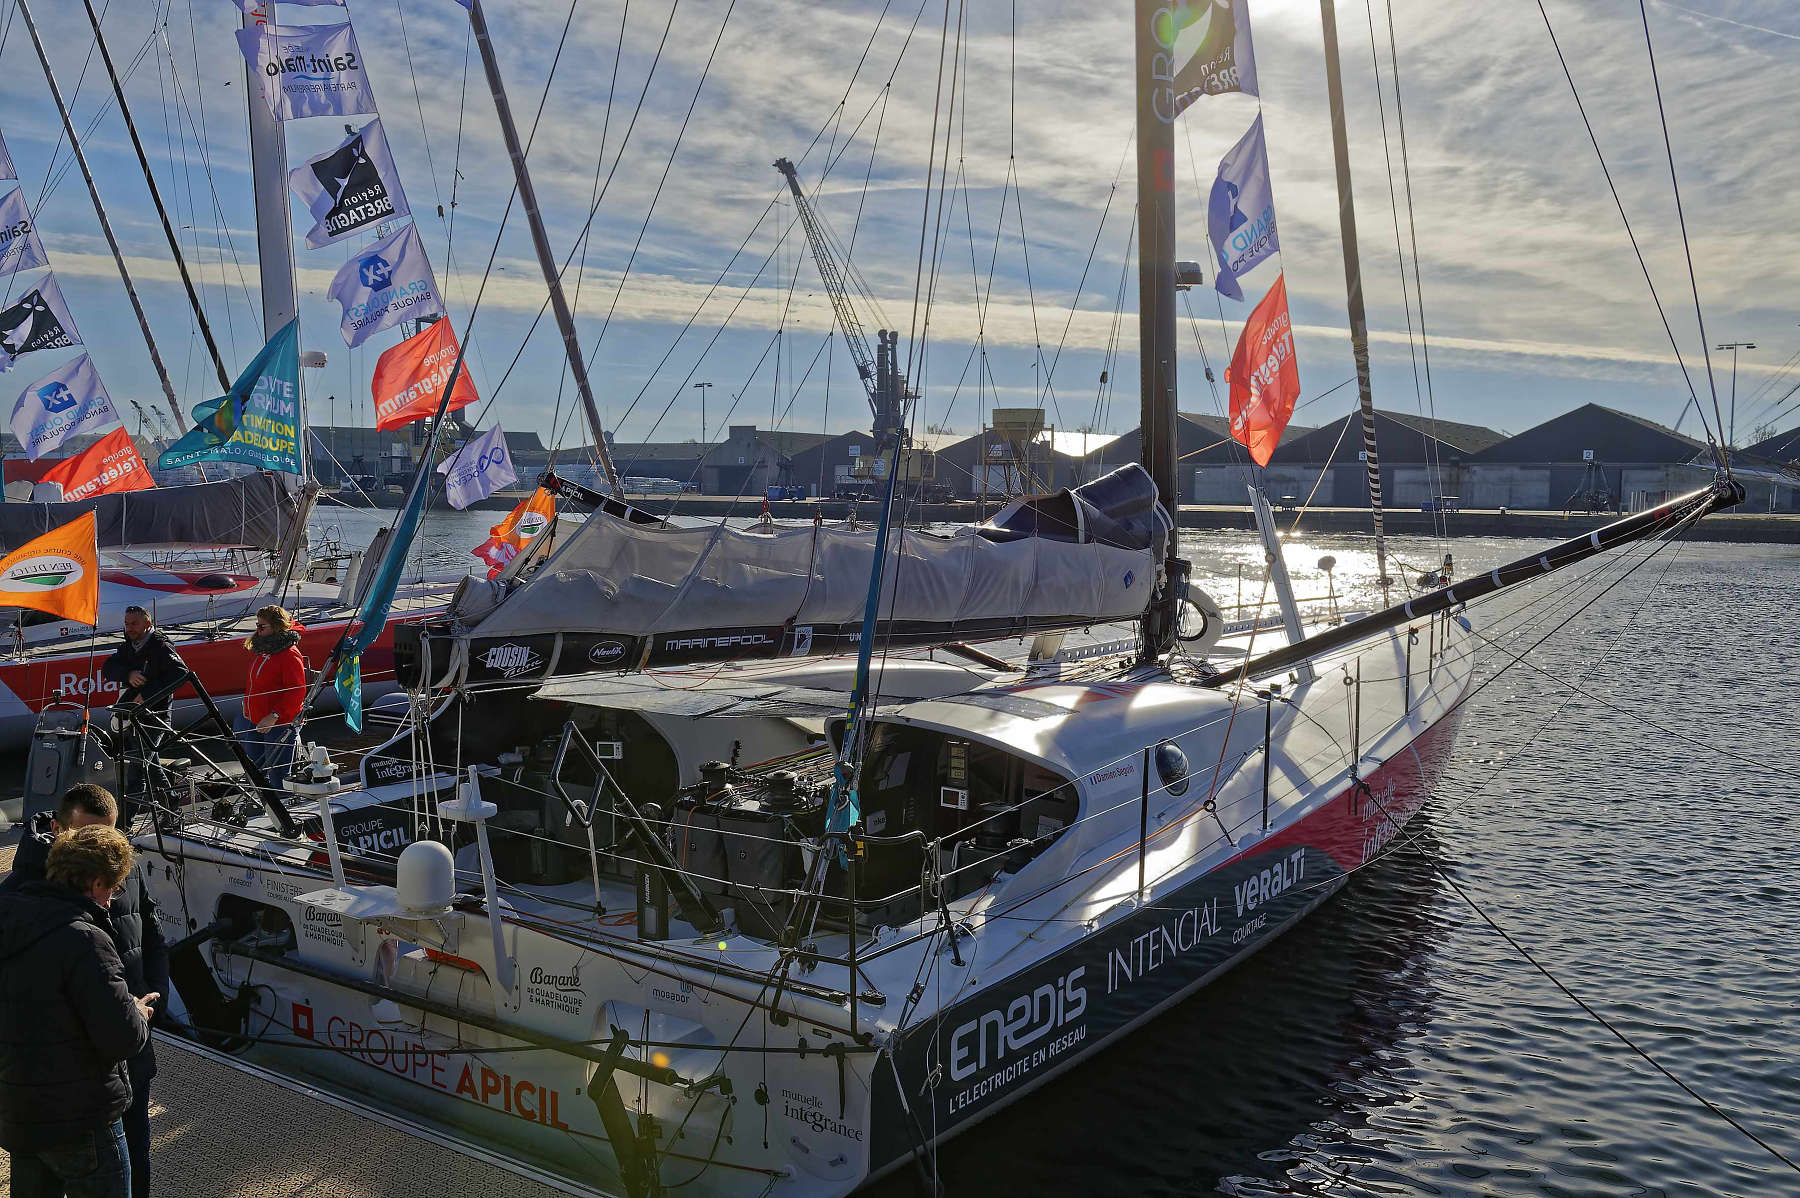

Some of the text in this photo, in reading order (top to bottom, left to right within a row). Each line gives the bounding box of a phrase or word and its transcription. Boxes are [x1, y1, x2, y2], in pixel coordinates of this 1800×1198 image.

[666, 633, 774, 651] MARINEPOOL
[486, 646, 530, 668] COUSIN
[60, 669, 122, 697] Rola
[341, 818, 384, 837] GROUPE
[347, 826, 412, 856] APICIL
[310, 932, 344, 947] MARTINIQUE
[1232, 912, 1267, 944] COURTAGE
[1108, 897, 1221, 995] INTENCIAL
[530, 966, 584, 993] Banane
[534, 997, 580, 1015] MARTINIQUE
[535, 988, 582, 1008] GUADELOUPE
[327, 1016, 448, 1089] GROUPE
[950, 1024, 1087, 1115] L'ELECTRICITE EN RESEAU
[456, 1060, 568, 1130] APICIL
[782, 1088, 823, 1109] mutuelle
[784, 1100, 863, 1142] intégrance
